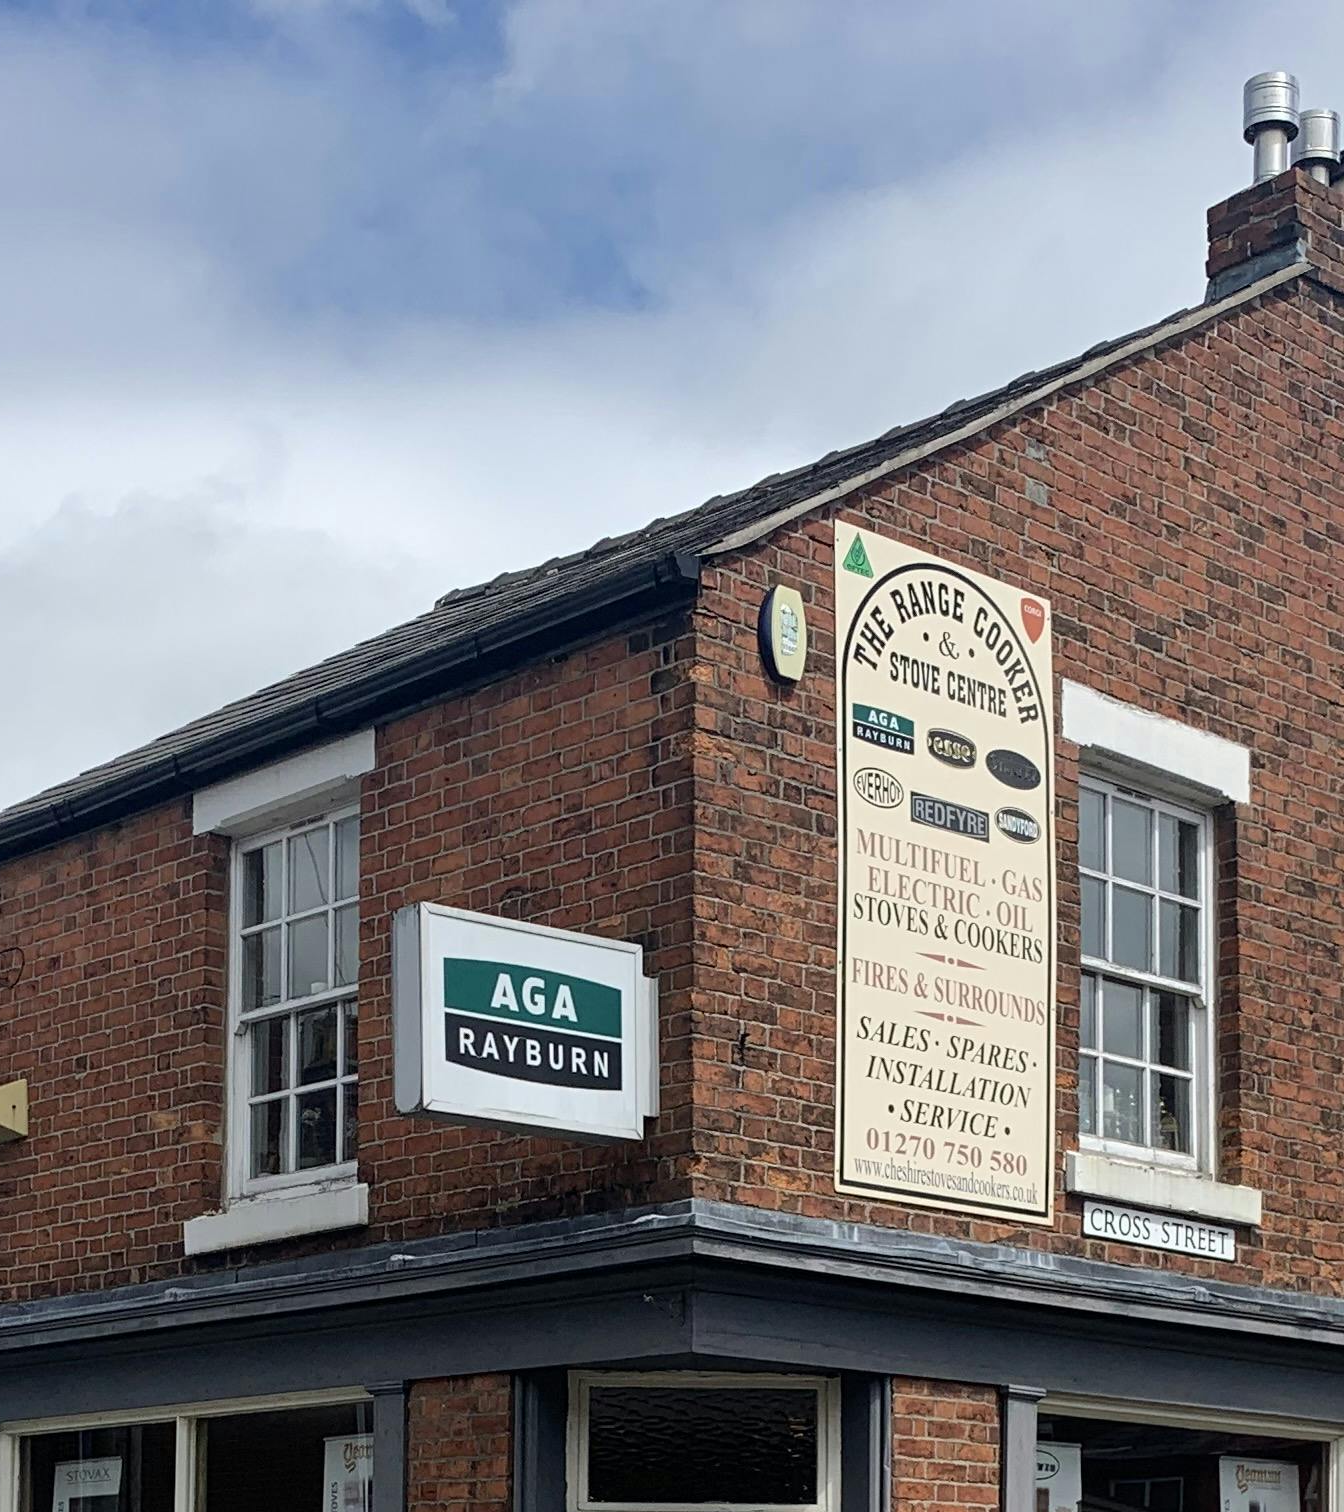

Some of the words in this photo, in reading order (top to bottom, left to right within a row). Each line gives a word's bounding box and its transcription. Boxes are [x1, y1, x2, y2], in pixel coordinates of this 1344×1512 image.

[854, 605, 894, 671] THE
[890, 581, 964, 624] RANGE
[974, 607, 1038, 724] COOKER
[939, 632, 960, 659] &
[890, 652, 940, 696] STOVE
[947, 671, 1007, 717] CENTRE
[857, 725, 911, 750] RAYBURN
[868, 710, 899, 730] AGA
[857, 774, 901, 804] EVERHOT
[915, 801, 985, 835] REDFYRE
[857, 828, 986, 887] MULTIFUEL
[1002, 869, 1042, 902] GAS
[868, 866, 980, 918] ELECTRIC
[997, 901, 1033, 933] OIL
[854, 893, 928, 935] STOVES
[934, 914, 948, 940] &
[955, 919, 1042, 964] COOKERS
[490, 973, 578, 1022] AGA
[852, 957, 908, 995] FIRES
[914, 973, 928, 999] &
[934, 977, 1045, 1025] SURROUNDS
[459, 1027, 608, 1078] RAYBURN
[857, 1016, 930, 1052] SALES
[947, 1035, 1028, 1073] SPARES
[866, 1055, 1031, 1108] INSTALLATION
[901, 1099, 998, 1138] SERVICE
[866, 1128, 935, 1160] 01270
[944, 1141, 982, 1168] 750
[990, 1150, 1027, 1176] 580
[854, 1157, 1038, 1204] www.cheshirestovesandcookers.co.uk
[1091, 1208, 1150, 1240] CROSS
[1162, 1222, 1228, 1254] STREET
[67, 1468, 110, 1481] STOVAX
